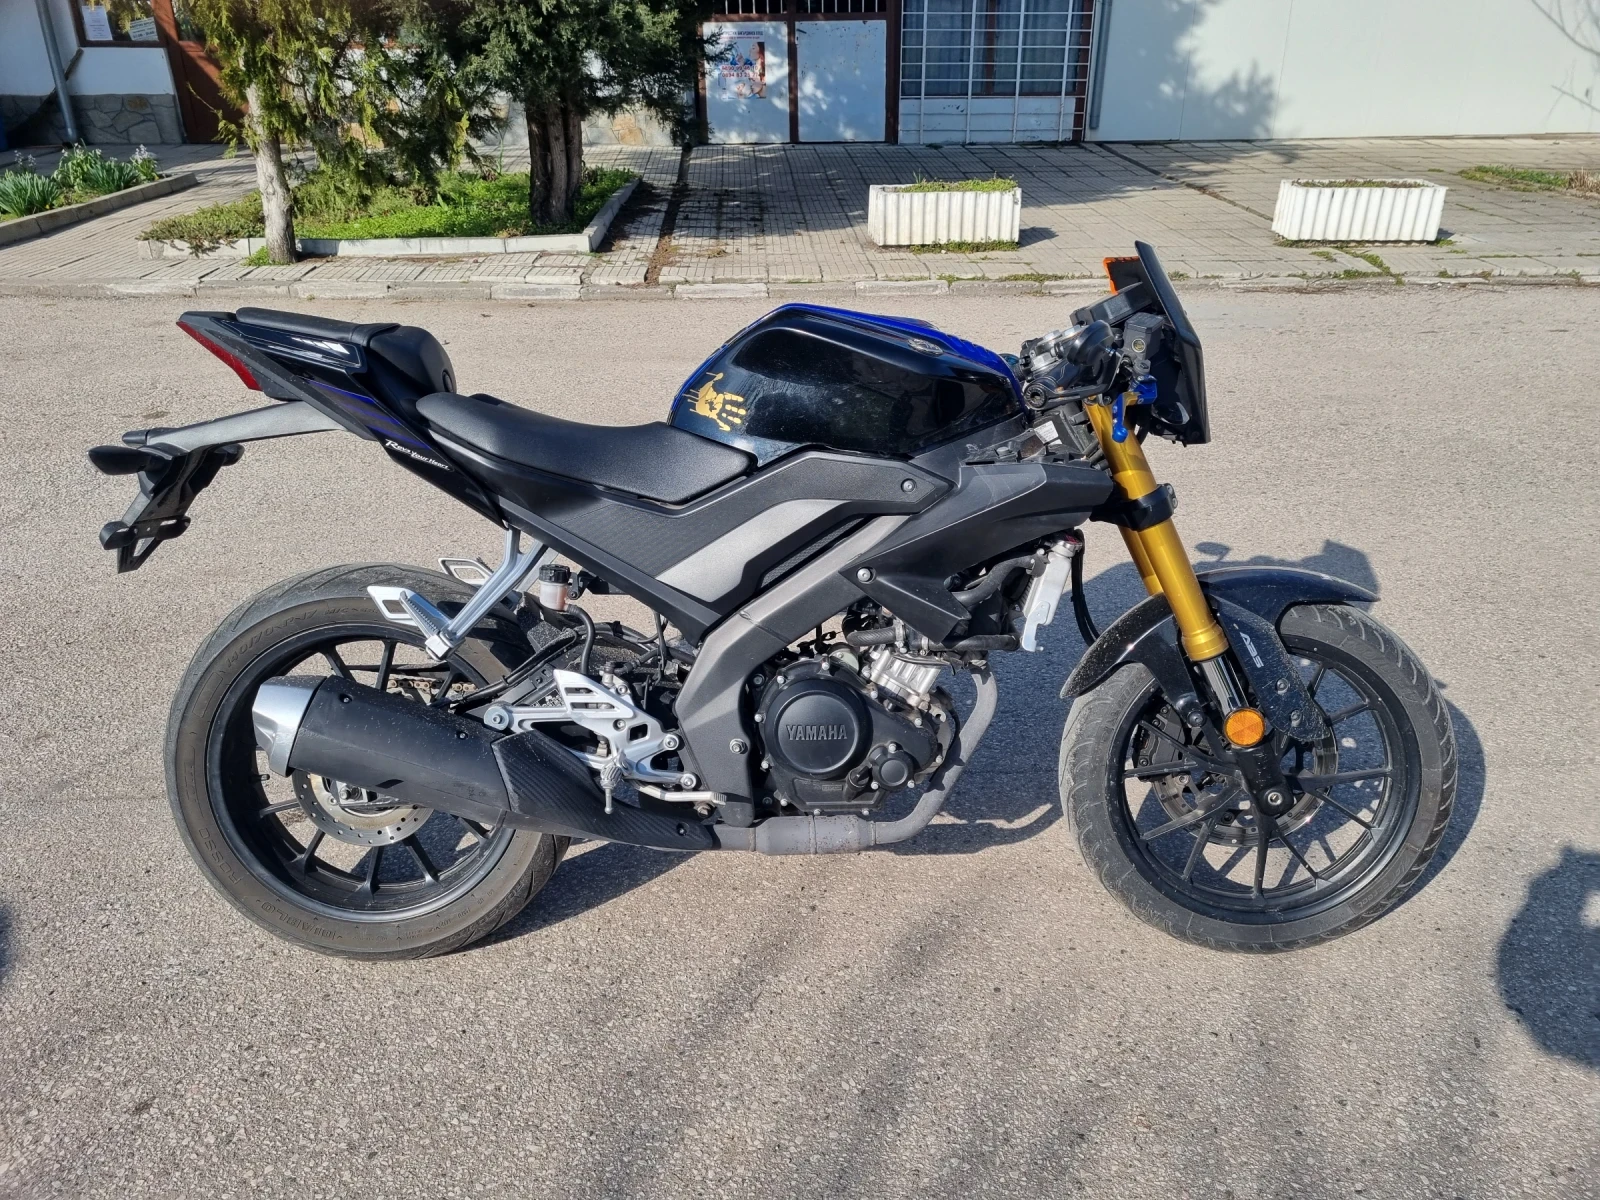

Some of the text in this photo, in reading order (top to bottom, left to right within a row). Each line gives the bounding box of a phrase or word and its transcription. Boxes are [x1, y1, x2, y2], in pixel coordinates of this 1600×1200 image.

[1240, 632, 1264, 668] ABS
[786, 724, 848, 741] YAMAHA
[199, 828, 242, 884] ROSSO
[261, 901, 337, 940] DIABLO
